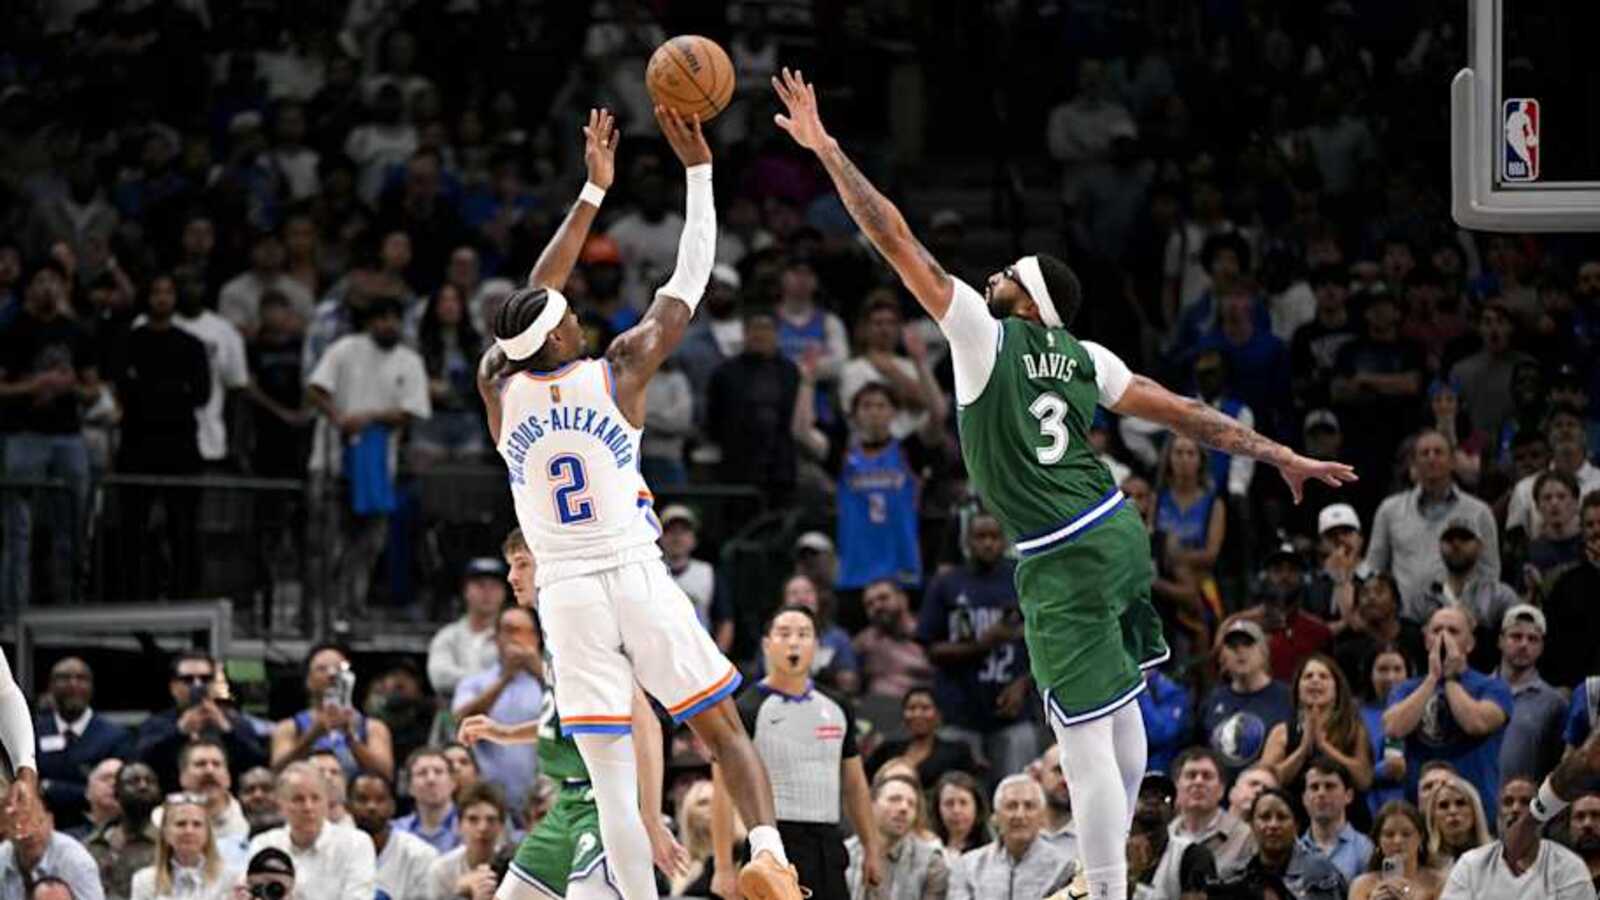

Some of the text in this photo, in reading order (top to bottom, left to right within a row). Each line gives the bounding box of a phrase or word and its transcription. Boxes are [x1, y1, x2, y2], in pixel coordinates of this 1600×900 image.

[1022, 352, 1077, 382] DAVIS
[1028, 391, 1069, 465] 3
[548, 452, 597, 524] 2
